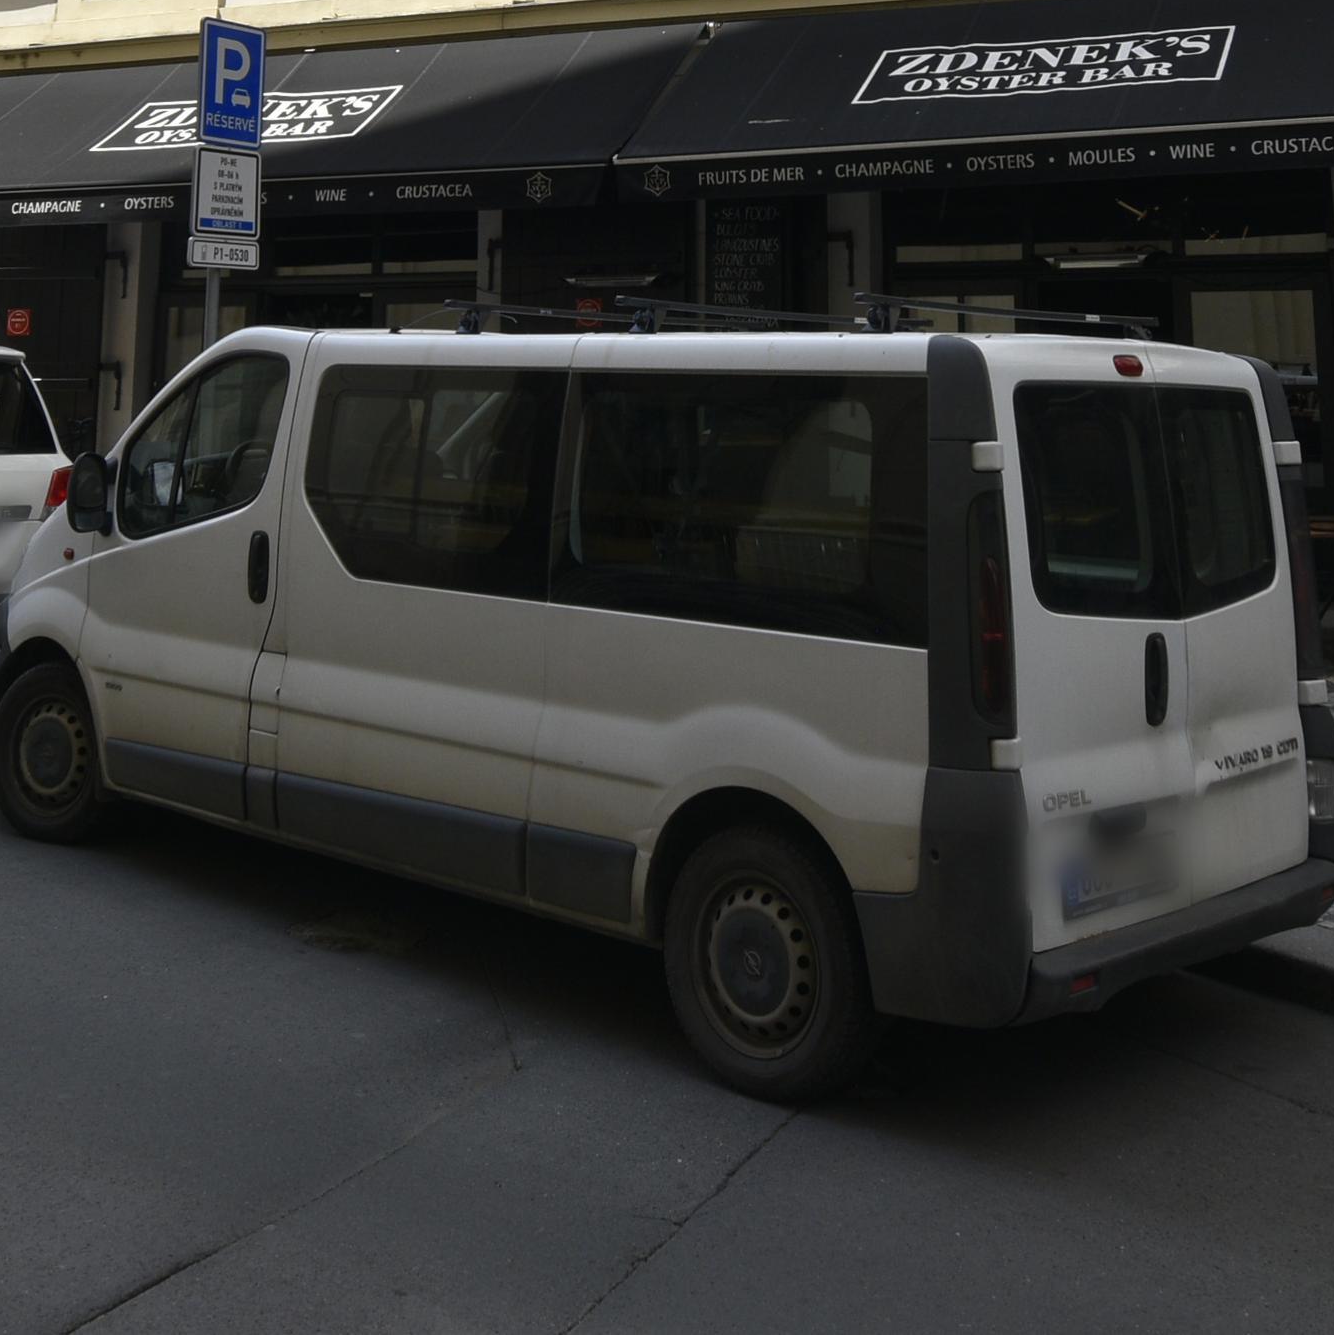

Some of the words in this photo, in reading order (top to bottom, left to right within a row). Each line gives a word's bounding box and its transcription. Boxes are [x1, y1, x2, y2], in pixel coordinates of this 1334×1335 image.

[888, 33, 1212, 77] ZDENEK'S
[214, 36, 251, 104] P
[903, 70, 1066, 93] OYSTER
[1077, 62, 1173, 83] BAR
[206, 111, 255, 132] RÉSERVÉ
[261, 120, 334, 137] BAR
[698, 170, 747, 187] FRUITS
[750, 169, 770, 184] DE
[772, 167, 804, 182] MER
[835, 159, 934, 178] CHAMPAGNE
[966, 153, 1035, 171] OYSTERS
[1068, 147, 1136, 166] MOULES
[1168, 143, 1215, 160] WINE
[11, 200, 82, 215] CHAMPAGNE
[124, 196, 175, 211] OYSTERS
[315, 188, 347, 202] WINE
[396, 183, 473, 200] CRUSTACEA
[213, 246, 249, 262] P1-0530
[1215, 749, 1259, 770] VIVARO
[1043, 790, 1091, 812] OPEL
